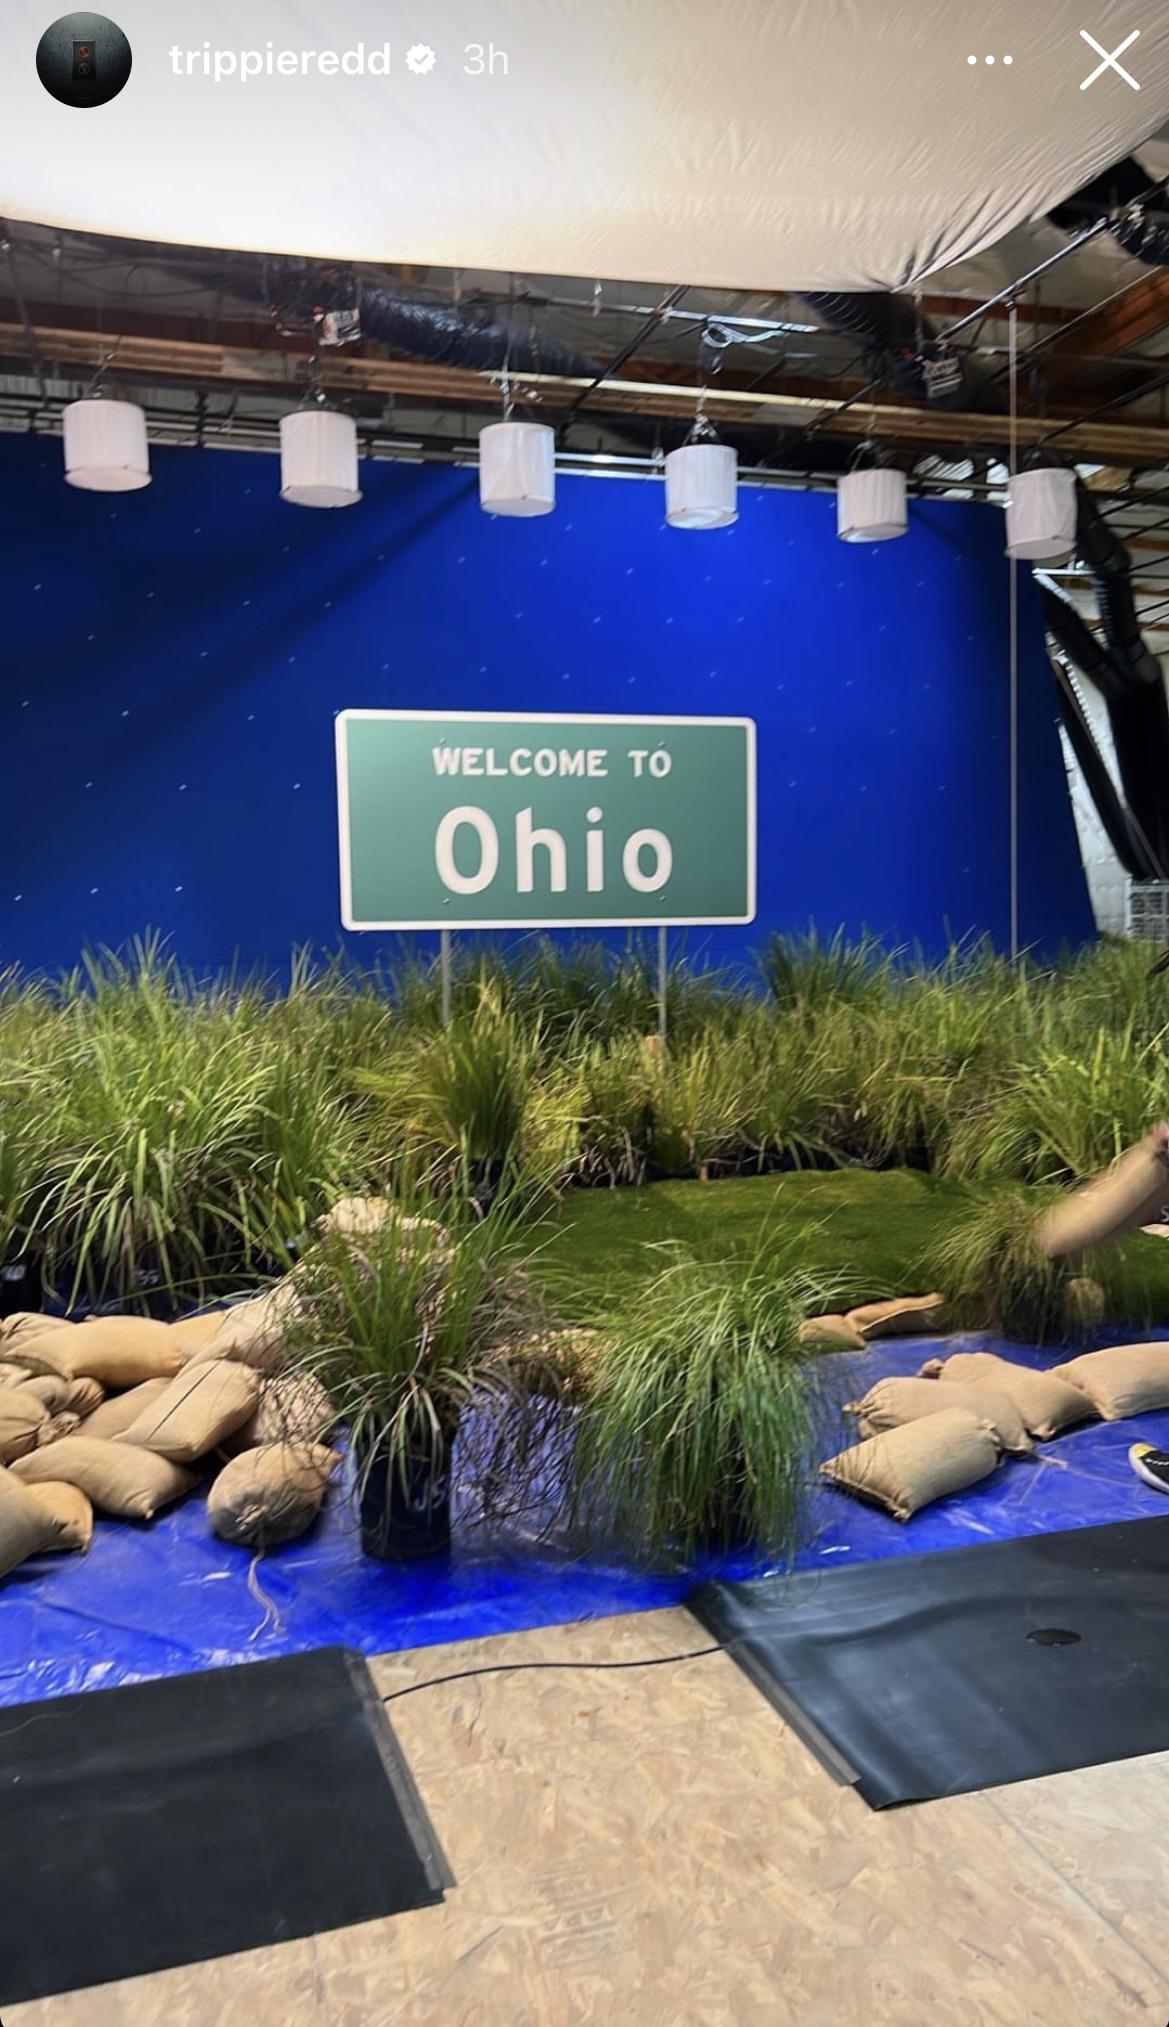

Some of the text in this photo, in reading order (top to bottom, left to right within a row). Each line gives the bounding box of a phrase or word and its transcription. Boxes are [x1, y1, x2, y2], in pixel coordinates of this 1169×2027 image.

[432, 747, 672, 778] WELCOME TO
[435, 805, 673, 894] Ohio
